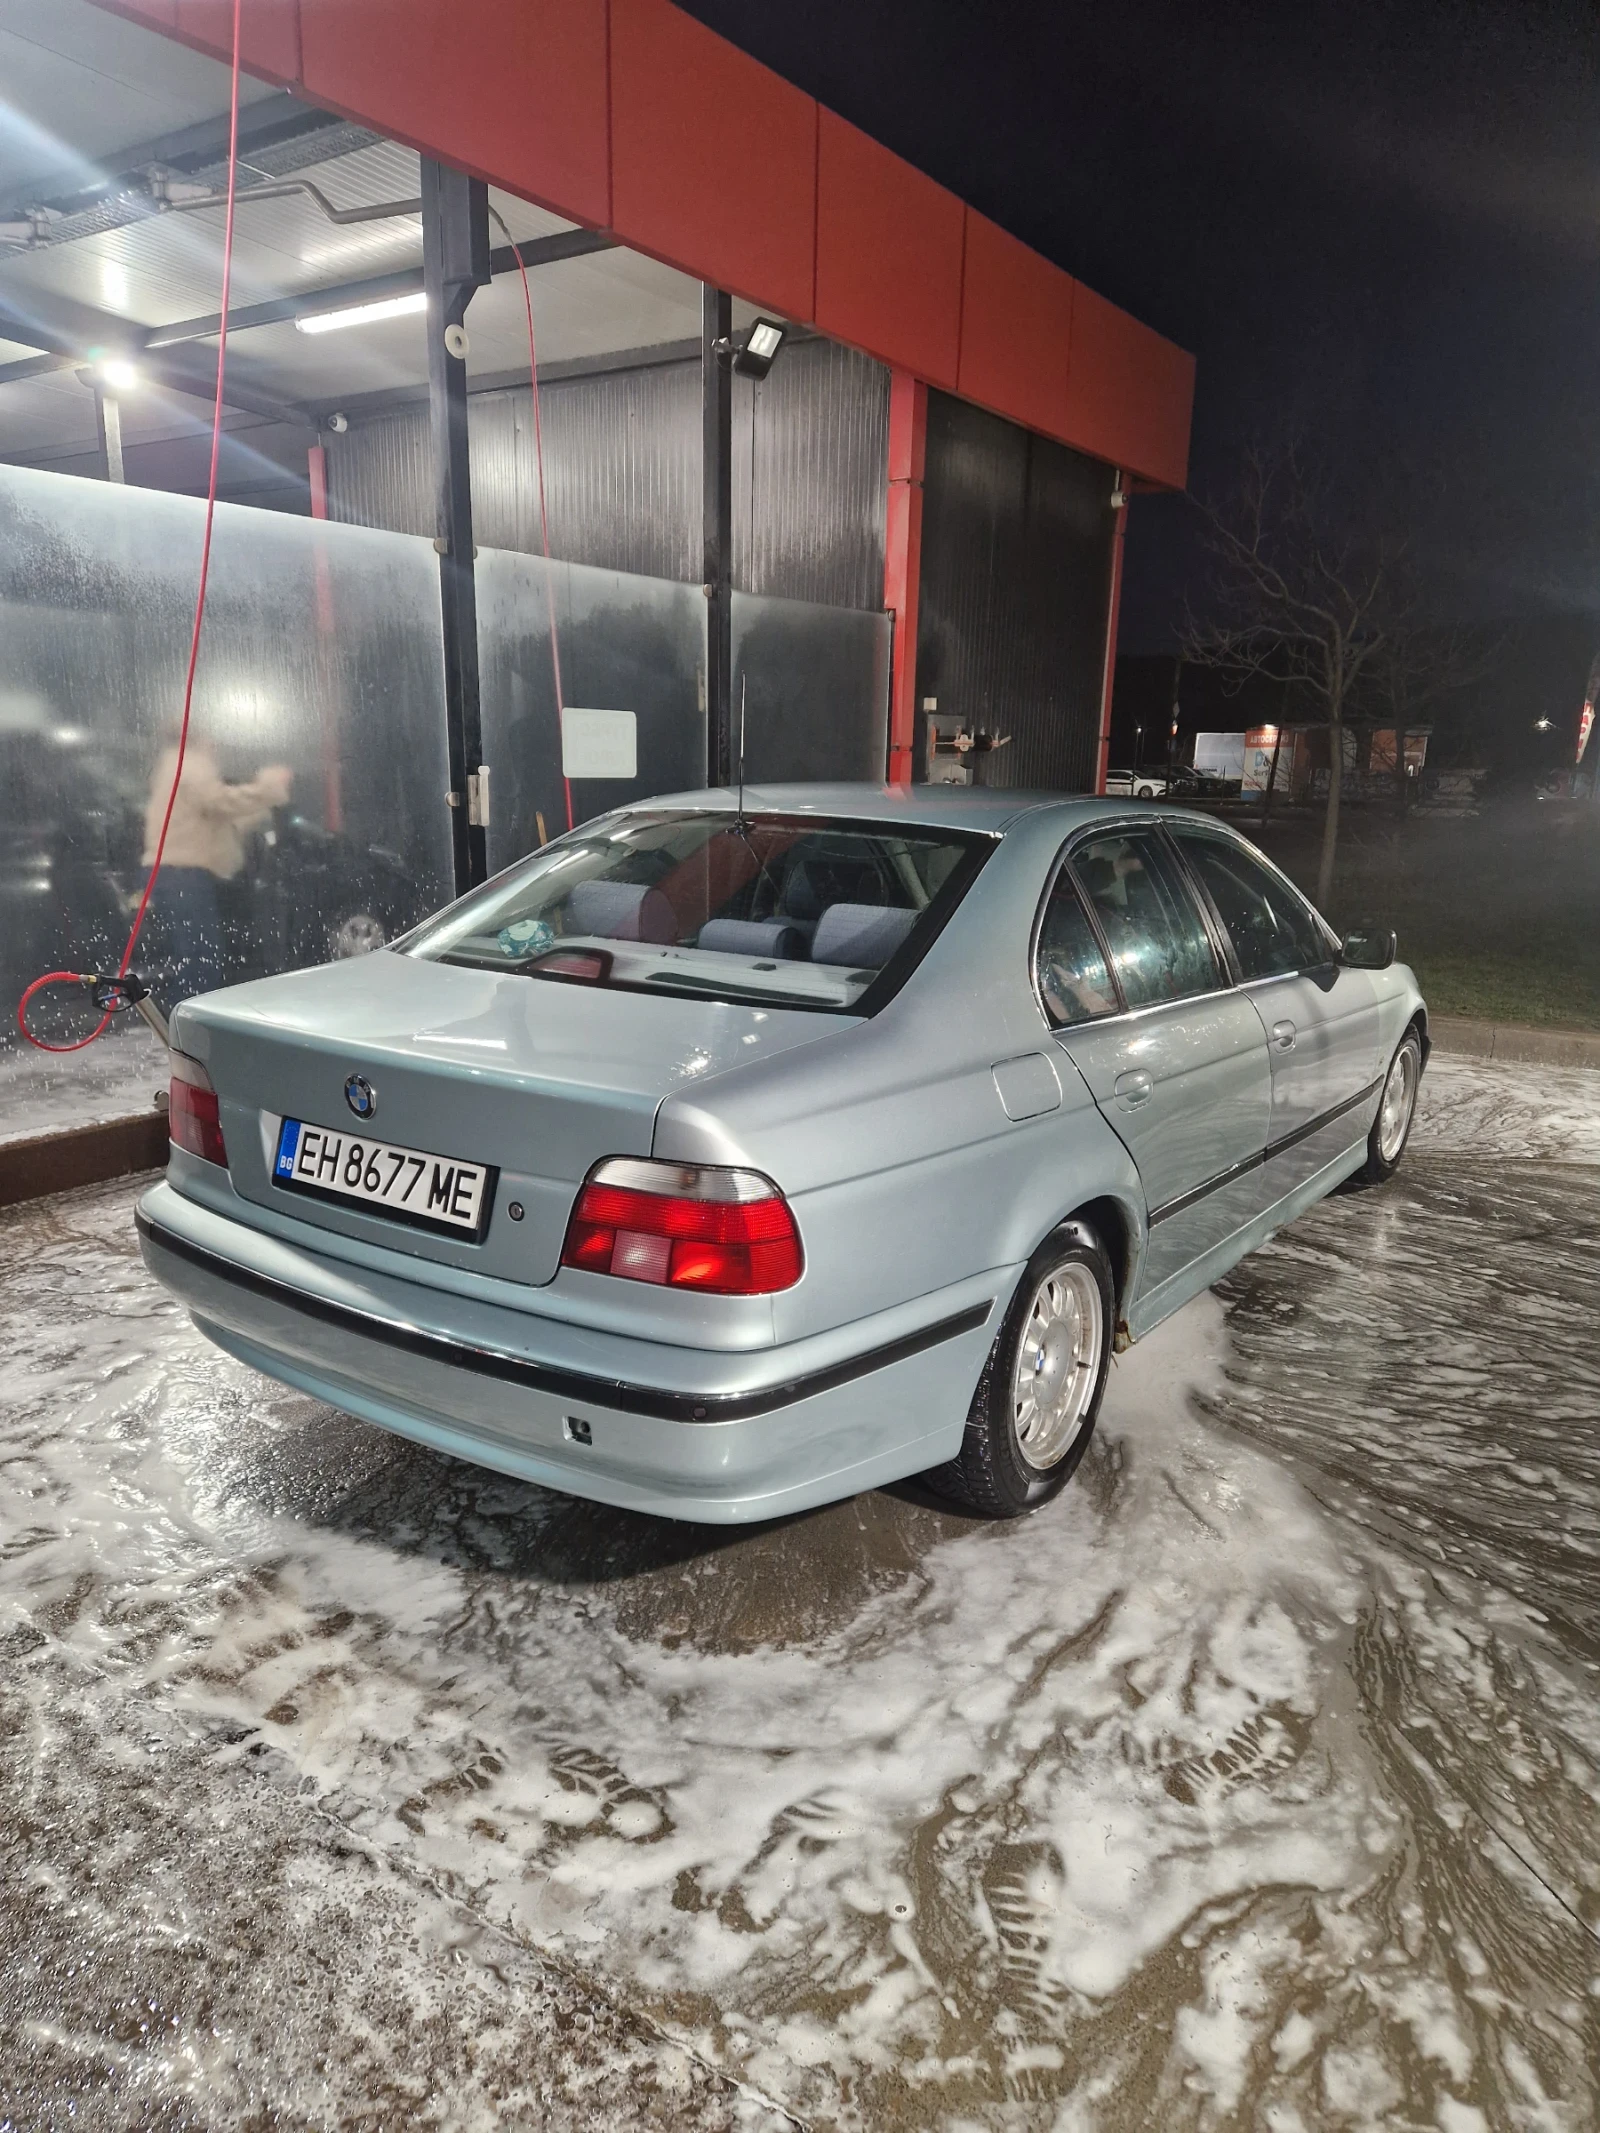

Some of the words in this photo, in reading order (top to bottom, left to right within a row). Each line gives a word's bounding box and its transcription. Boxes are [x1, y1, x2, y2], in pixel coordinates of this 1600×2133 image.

[1250, 734, 1289, 744] АВТОСЕРИЗ
[280, 1155, 293, 1170] BG
[298, 1131, 342, 1182] EH
[344, 1143, 426, 1202] 8677
[427, 1163, 477, 1220] ME
